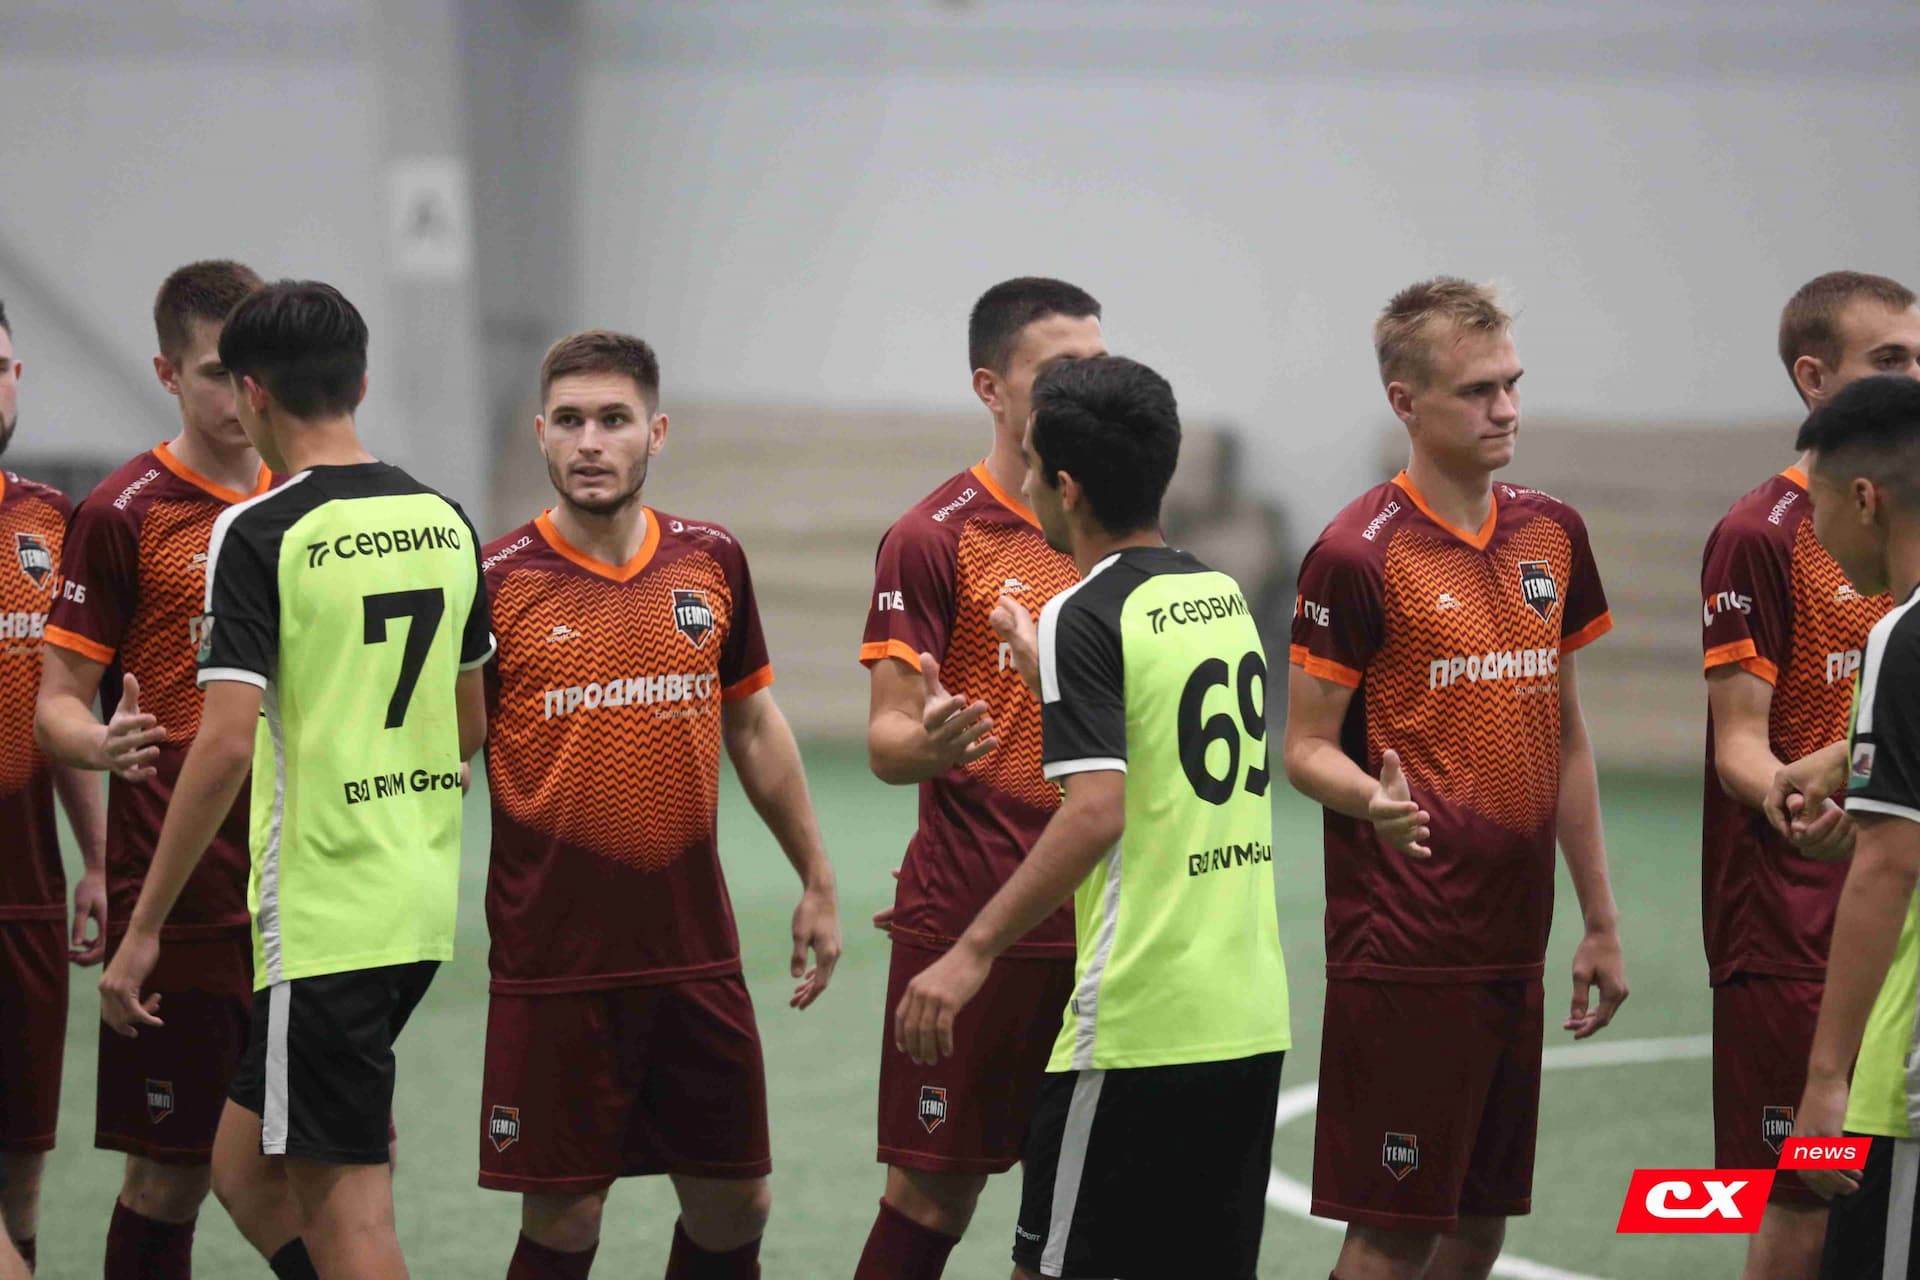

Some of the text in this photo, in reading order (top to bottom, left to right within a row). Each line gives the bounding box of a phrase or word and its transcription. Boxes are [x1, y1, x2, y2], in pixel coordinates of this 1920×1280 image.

[334, 526, 461, 559] сервико
[1523, 577, 1556, 600] ТЕМП
[676, 605, 711, 627] ТЕМП
[362, 587, 445, 730] 7
[544, 673, 716, 721] ПРОДИНВЕСТ
[1178, 651, 1270, 806] 69
[922, 1099, 944, 1118] ТЕМП
[492, 1119, 517, 1137] ТЕМП
[1765, 1119, 1792, 1137] ТЕМП
[1386, 1146, 1415, 1165] ТЕМП
